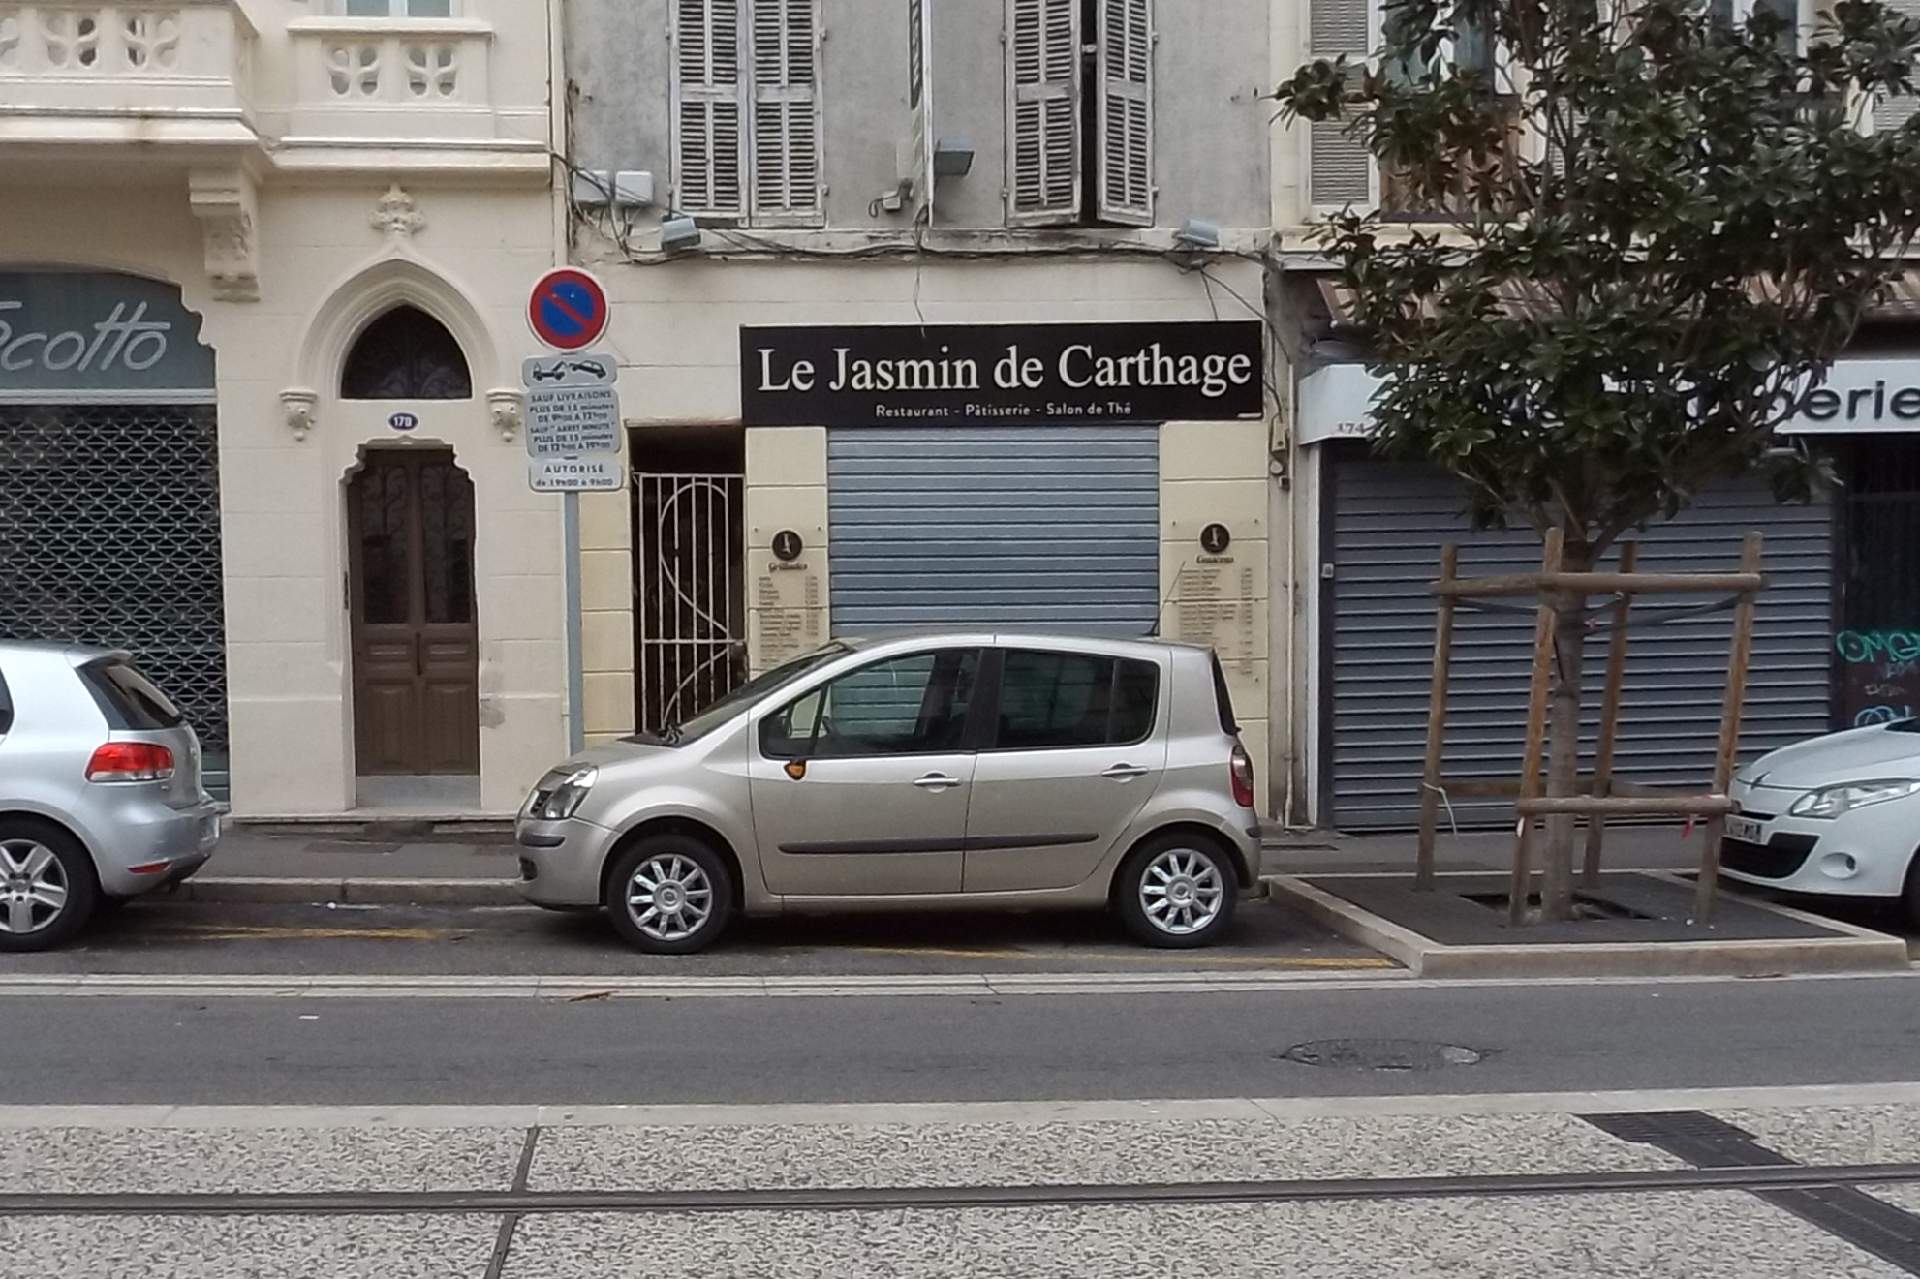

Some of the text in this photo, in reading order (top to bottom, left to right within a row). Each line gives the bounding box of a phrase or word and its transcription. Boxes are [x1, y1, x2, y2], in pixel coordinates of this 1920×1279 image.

[757, 343, 1252, 397] Le Jasmin de Carthage
[532, 391, 611, 402] SAUF LIVRAISONS
[876, 404, 949, 417] Restaurant
[1046, 402, 1082, 415] Salon
[1087, 402, 1103, 415] de
[1107, 401, 1132, 414] Thé
[538, 444, 548, 452] DE
